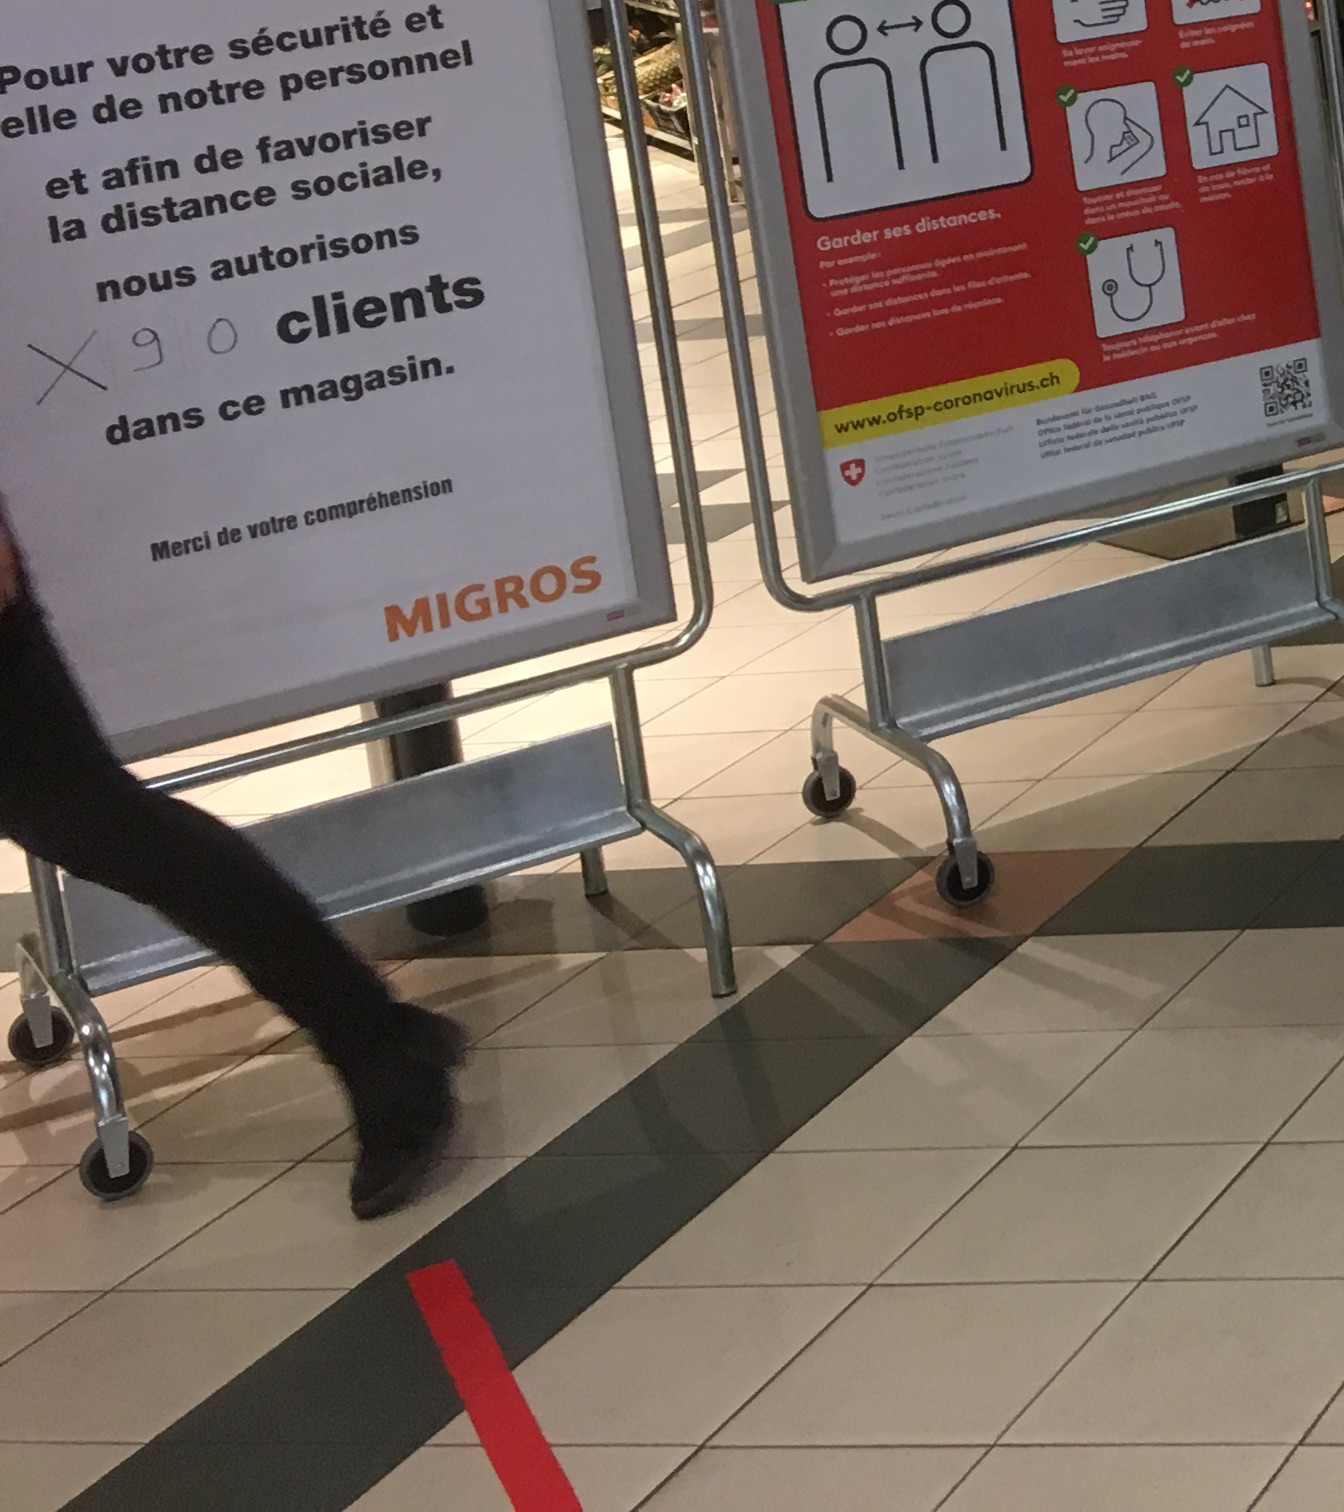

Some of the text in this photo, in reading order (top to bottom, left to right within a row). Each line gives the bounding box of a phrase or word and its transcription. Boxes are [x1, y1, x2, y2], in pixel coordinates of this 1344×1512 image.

[0, 4, 445, 95] Pour votre sécurité et
[0, 40, 475, 139] elle de notre personnel
[45, 114, 432, 199] et afin de favoriser
[47, 154, 443, 244] la distance sociale,
[95, 223, 421, 303] nous autorisons
[816, 206, 1002, 252] Garder ses distances.
[276, 273, 486, 345] clients
[105, 354, 456, 446] dans ce magasin.
[834, 371, 1061, 434] www.ofsp-coronavirus.ch
[150, 477, 454, 563] Merci de votre compréhension
[383, 554, 603, 642] MIGROS
